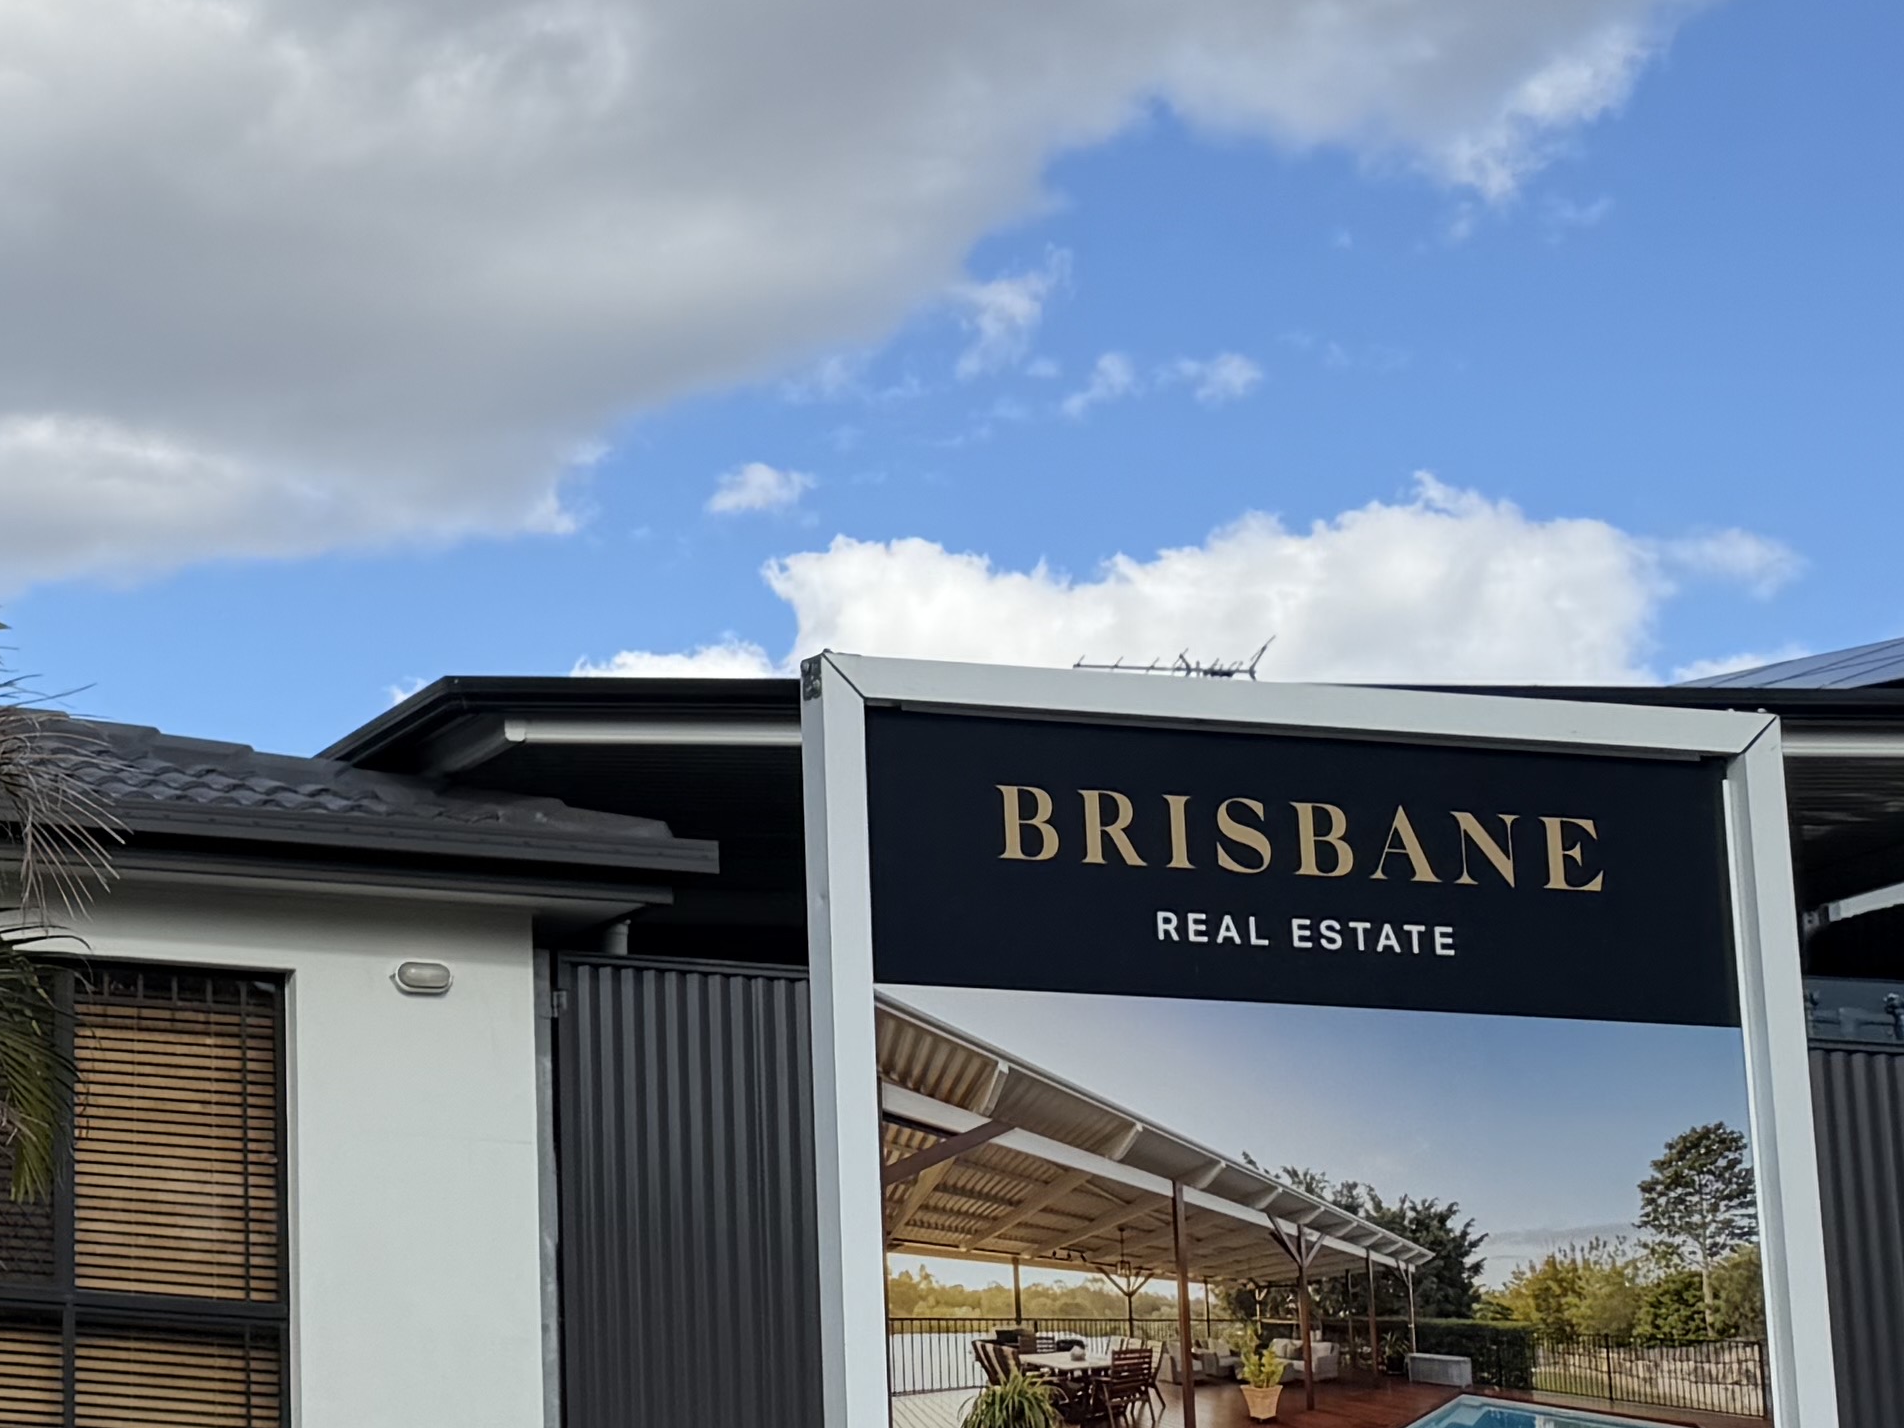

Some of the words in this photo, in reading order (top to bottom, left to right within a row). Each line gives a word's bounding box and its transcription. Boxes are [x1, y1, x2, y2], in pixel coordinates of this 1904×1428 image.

[996, 785, 1604, 892] BRISBANE
[1156, 910, 1270, 946] REAL
[1291, 918, 1456, 956] ESTATE
